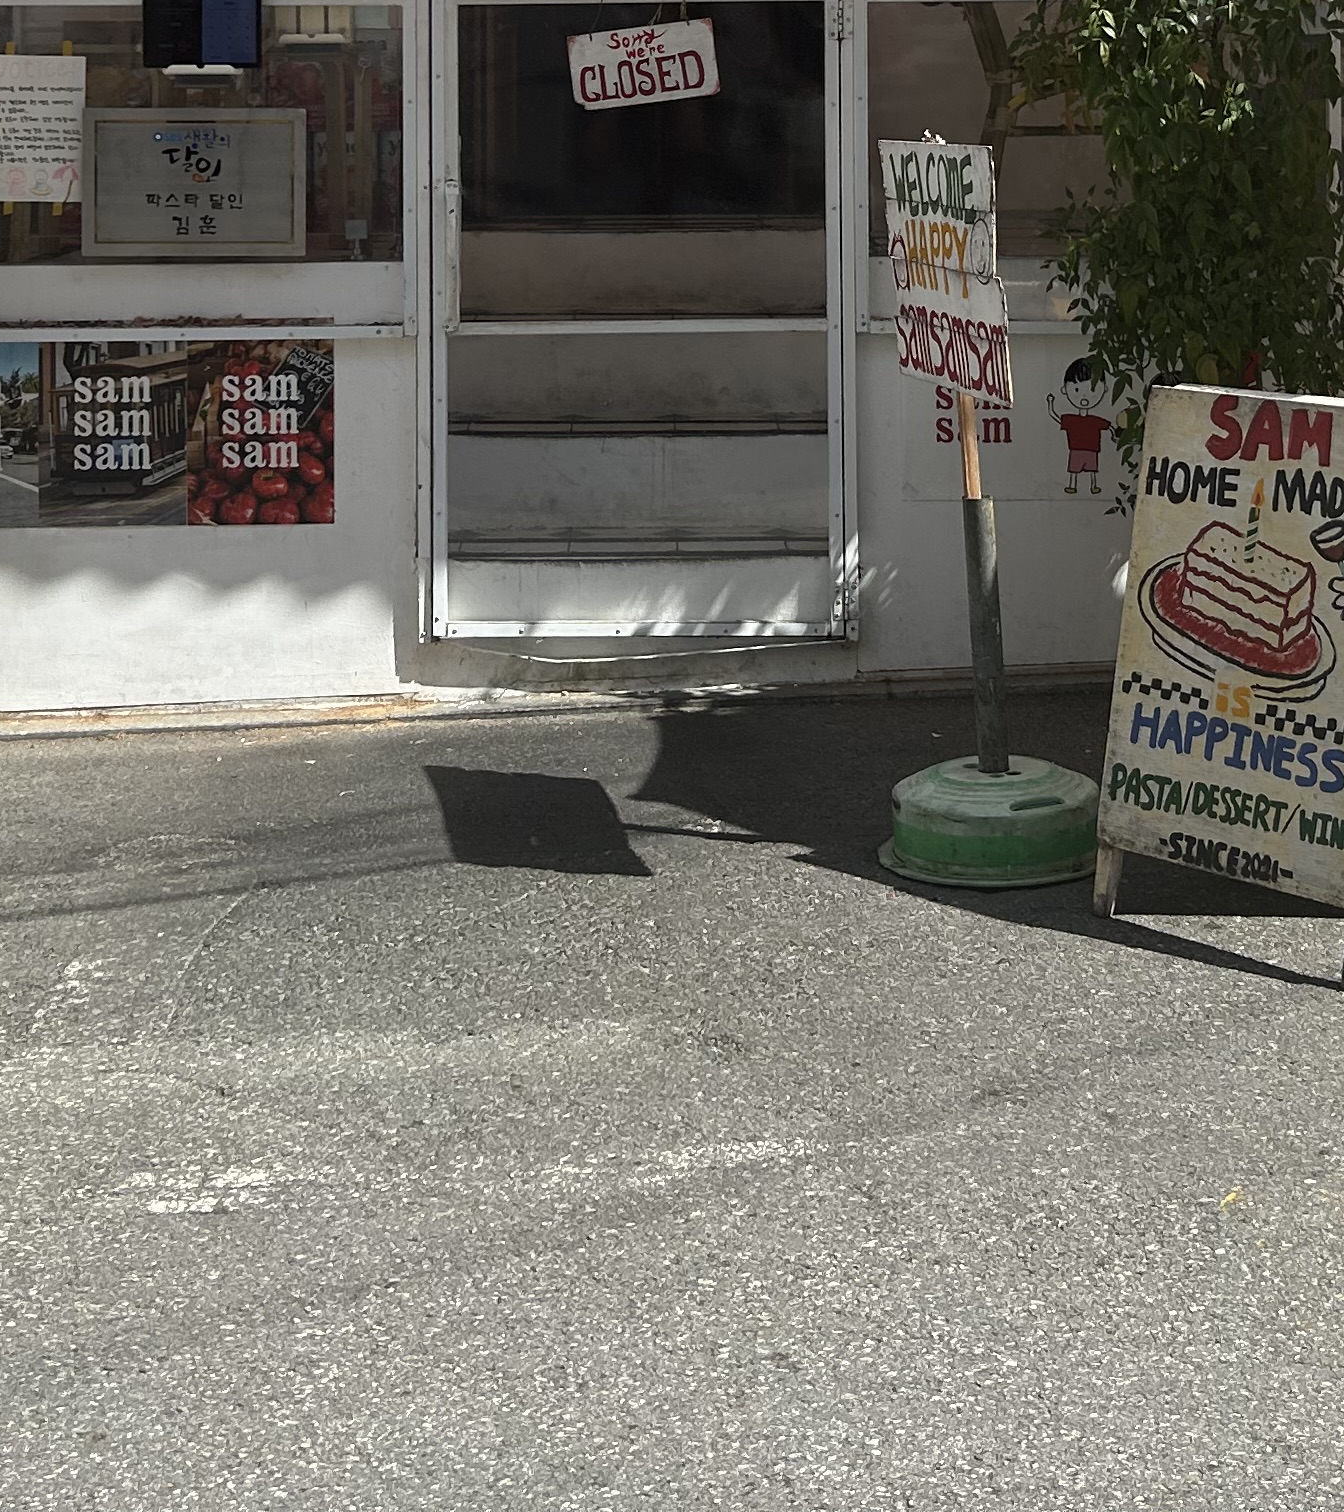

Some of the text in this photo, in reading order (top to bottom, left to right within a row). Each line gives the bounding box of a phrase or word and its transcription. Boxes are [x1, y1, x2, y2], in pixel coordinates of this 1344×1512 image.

[606, 28, 667, 49] Sorry
[626, 42, 665, 59] we're
[580, 50, 705, 102] CLOSED
[184, 129, 231, 149] 생활의
[162, 146, 221, 182] 달인
[146, 193, 244, 209] 파스타 달인
[889, 151, 977, 225] WELCOME
[905, 219, 968, 299] HAPPY
[74, 376, 152, 403] sam
[222, 374, 299, 401] sam
[74, 409, 152, 437] sam
[222, 408, 299, 435] sam
[936, 417, 1012, 443] sm
[1205, 394, 1333, 467] SAM
[74, 442, 152, 470] sam
[222, 441, 299, 468] sam
[1145, 456, 1240, 508] HOME
